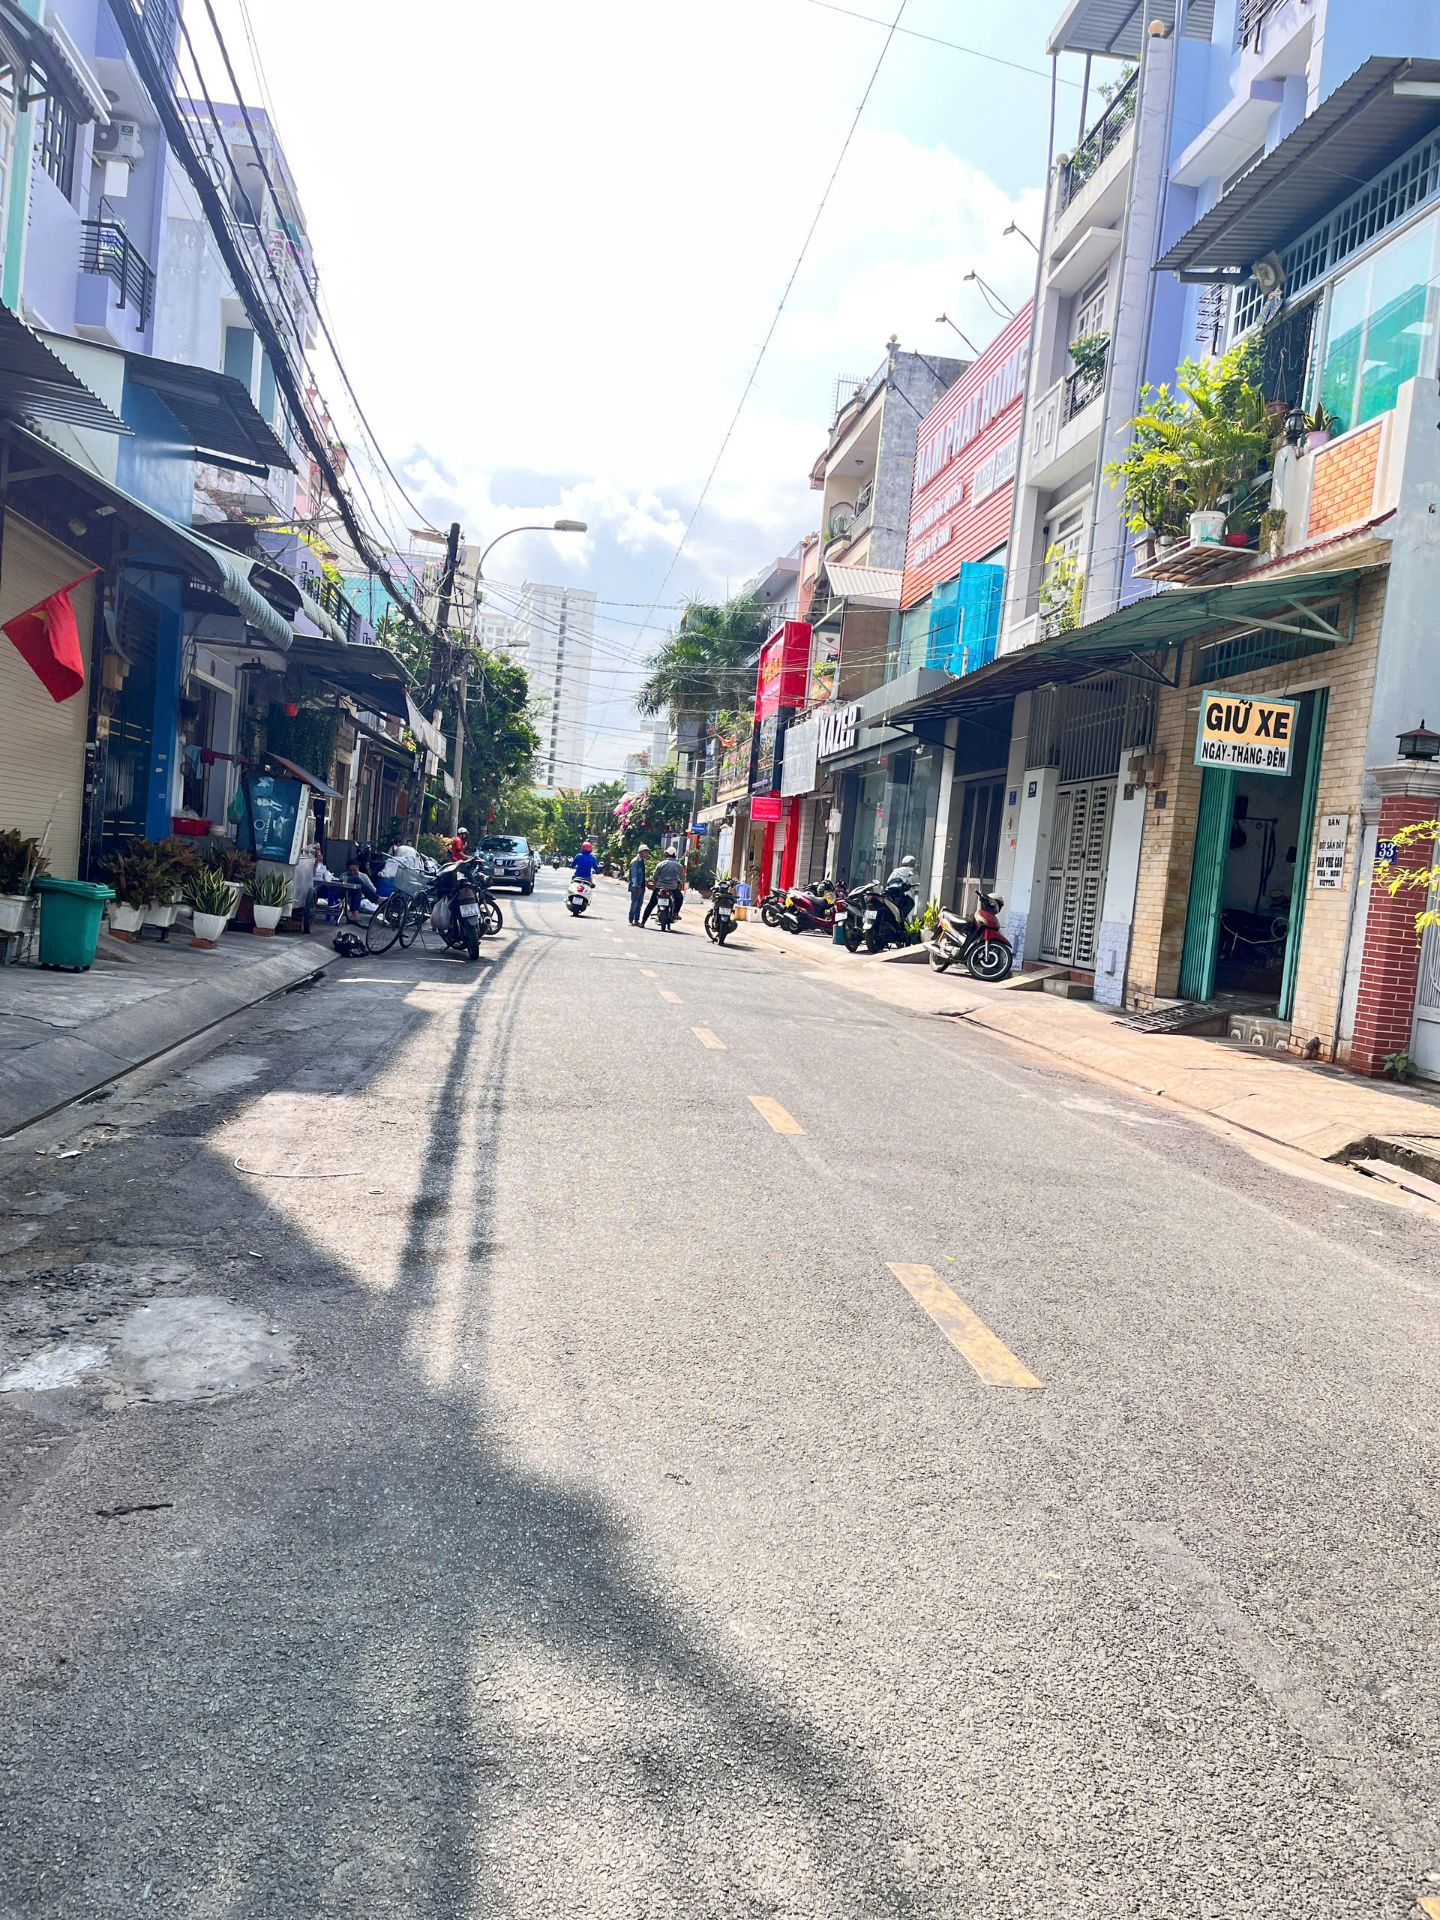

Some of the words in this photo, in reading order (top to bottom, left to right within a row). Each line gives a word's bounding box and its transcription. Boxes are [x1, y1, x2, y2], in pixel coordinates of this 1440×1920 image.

[818, 705, 857, 758] KAZER
[1206, 699, 1253, 735] GIỮ
[1254, 709, 1290, 740] XE
[1378, 842, 1394, 858] 33
